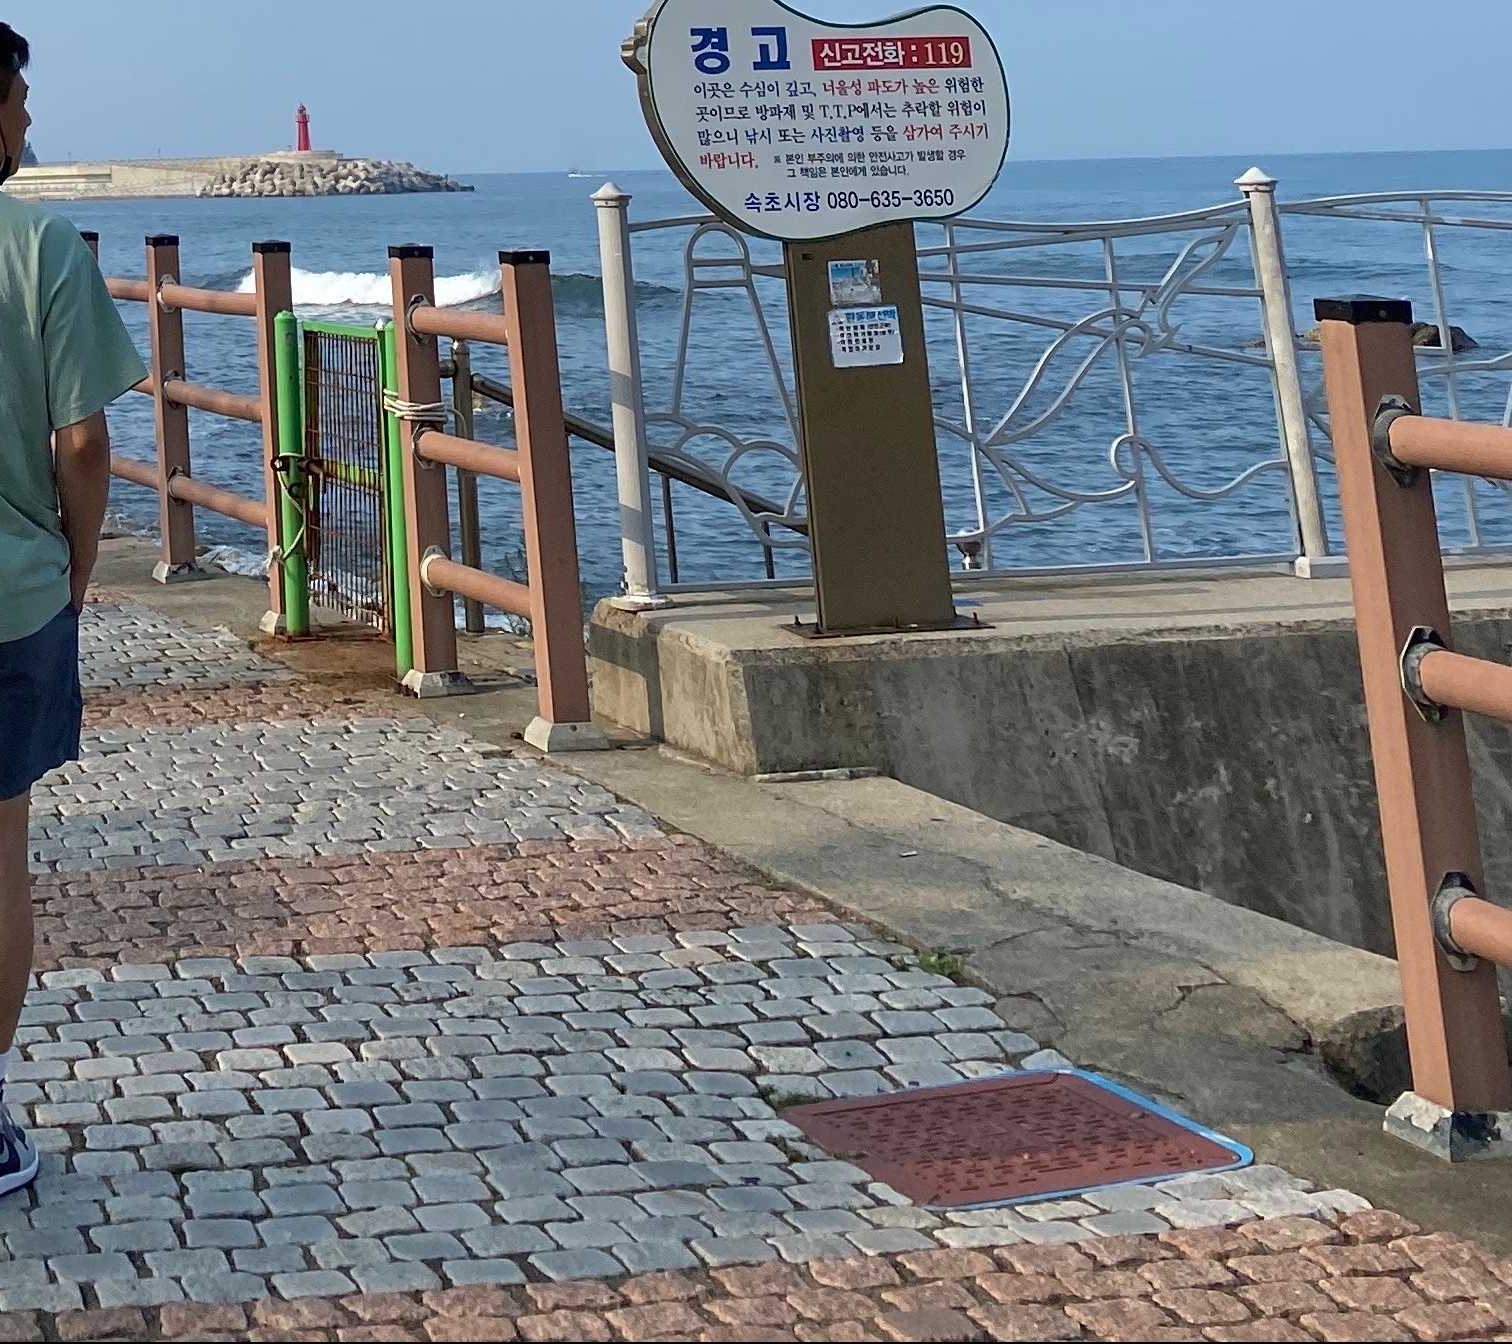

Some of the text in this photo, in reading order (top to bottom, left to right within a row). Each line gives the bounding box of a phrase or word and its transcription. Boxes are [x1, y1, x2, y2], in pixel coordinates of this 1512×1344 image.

[923, 41, 964, 65] 119
[693, 76, 984, 99] 이곳은 수심이 깊고, 너울성 파도가 높은 위험한
[695, 105, 751, 122] 곳이므로
[755, 104, 796, 121] 방파제
[802, 103, 815, 121] 및
[902, 101, 942, 118] 추락할
[947, 100, 986, 117] 위험이
[697, 122, 989, 146] 많으니 낚시 또는 사진촬영 등을 삼가여 주시기
[699, 152, 759, 169] 바랍니다.
[786, 153, 804, 165] 본인
[807, 152, 845, 164] 부주의에
[847, 151, 865, 163] 의한
[868, 150, 914, 163] 안전사고가
[917, 149, 944, 162] 발생할
[948, 149, 967, 161] 경우
[787, 168, 797, 178] 그
[800, 166, 827, 178] 책임은
[831, 166, 867, 178] 본인에게
[744, 188, 954, 212] 속초시장 080-635-3650
